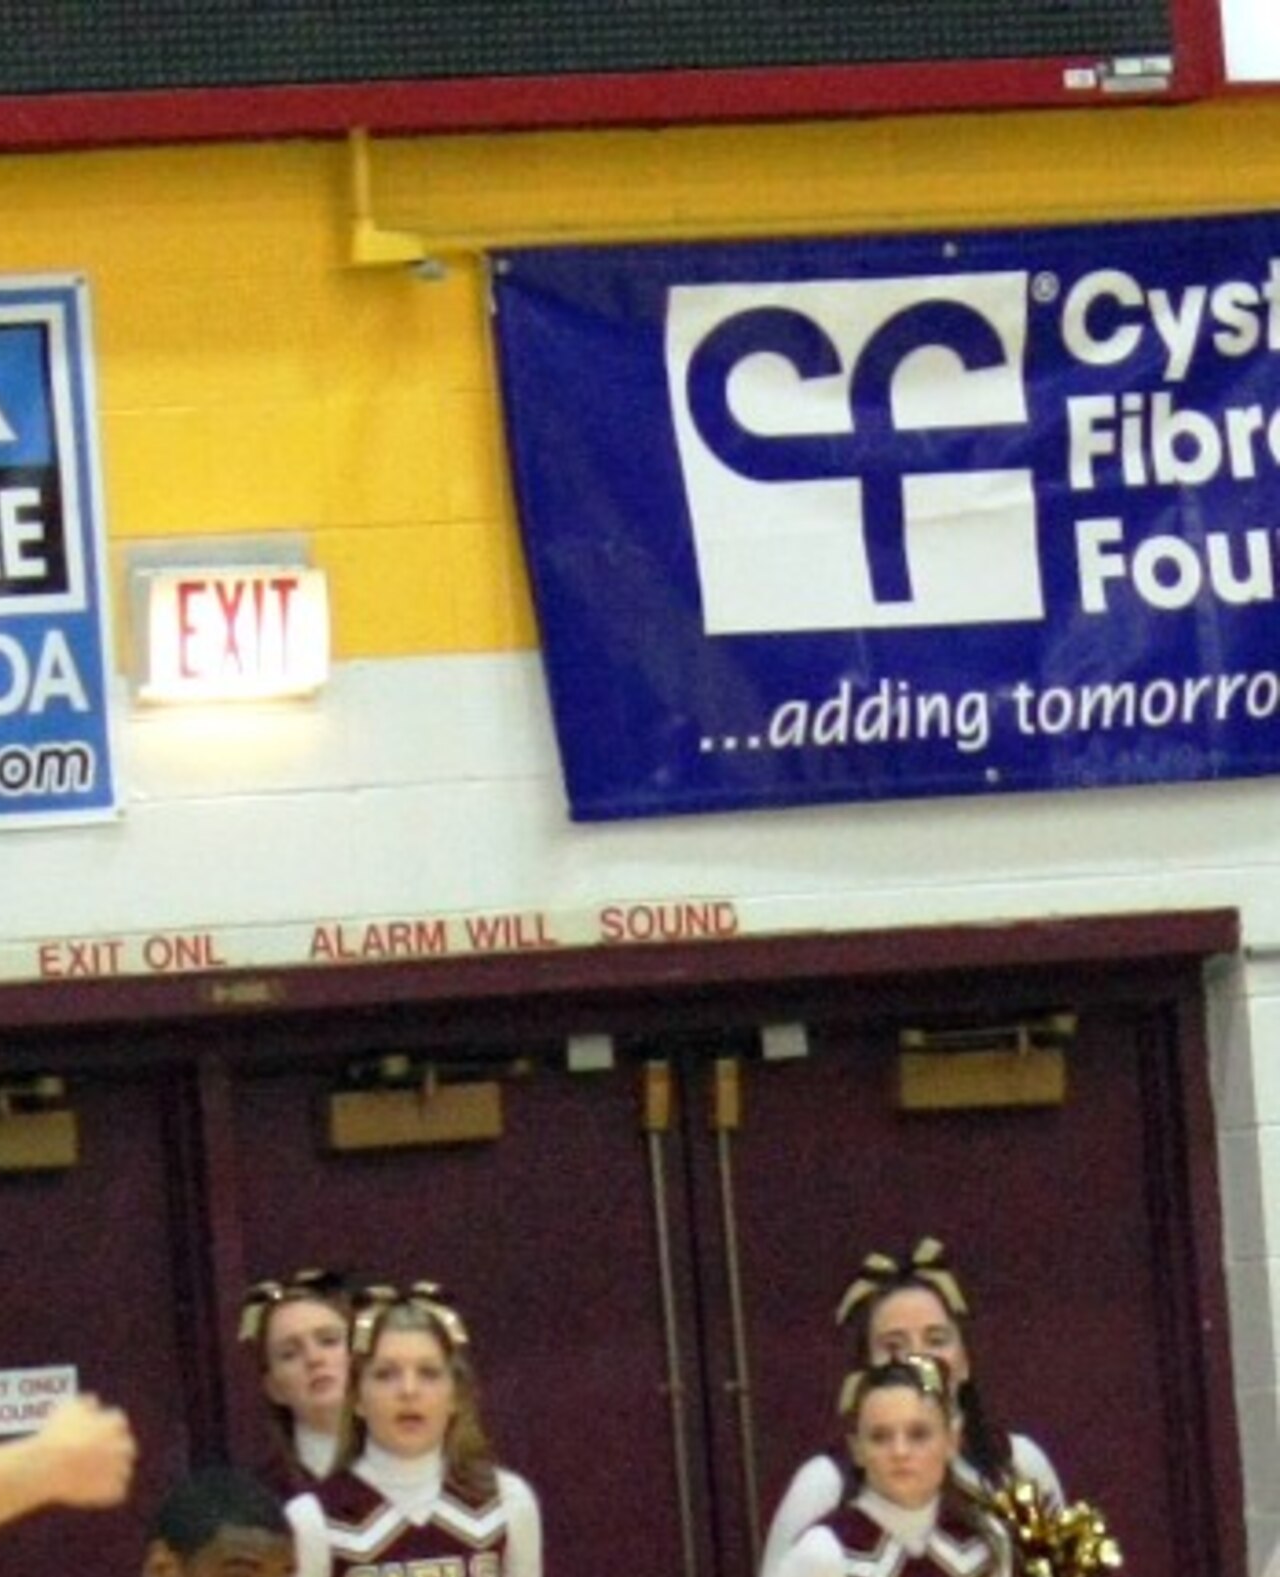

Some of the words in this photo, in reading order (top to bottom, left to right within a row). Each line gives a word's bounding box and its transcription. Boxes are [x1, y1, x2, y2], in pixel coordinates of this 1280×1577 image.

[1066, 390, 1280, 490] Fibr
[176, 576, 299, 680] EXIT
[40, 939, 123, 978] EXIT
[143, 934, 227, 971] ONL
[308, 919, 449, 960] ALARM
[465, 912, 559, 949] WILL
[599, 901, 739, 943] SOUND
[18, 1376, 69, 1396] ONLY
